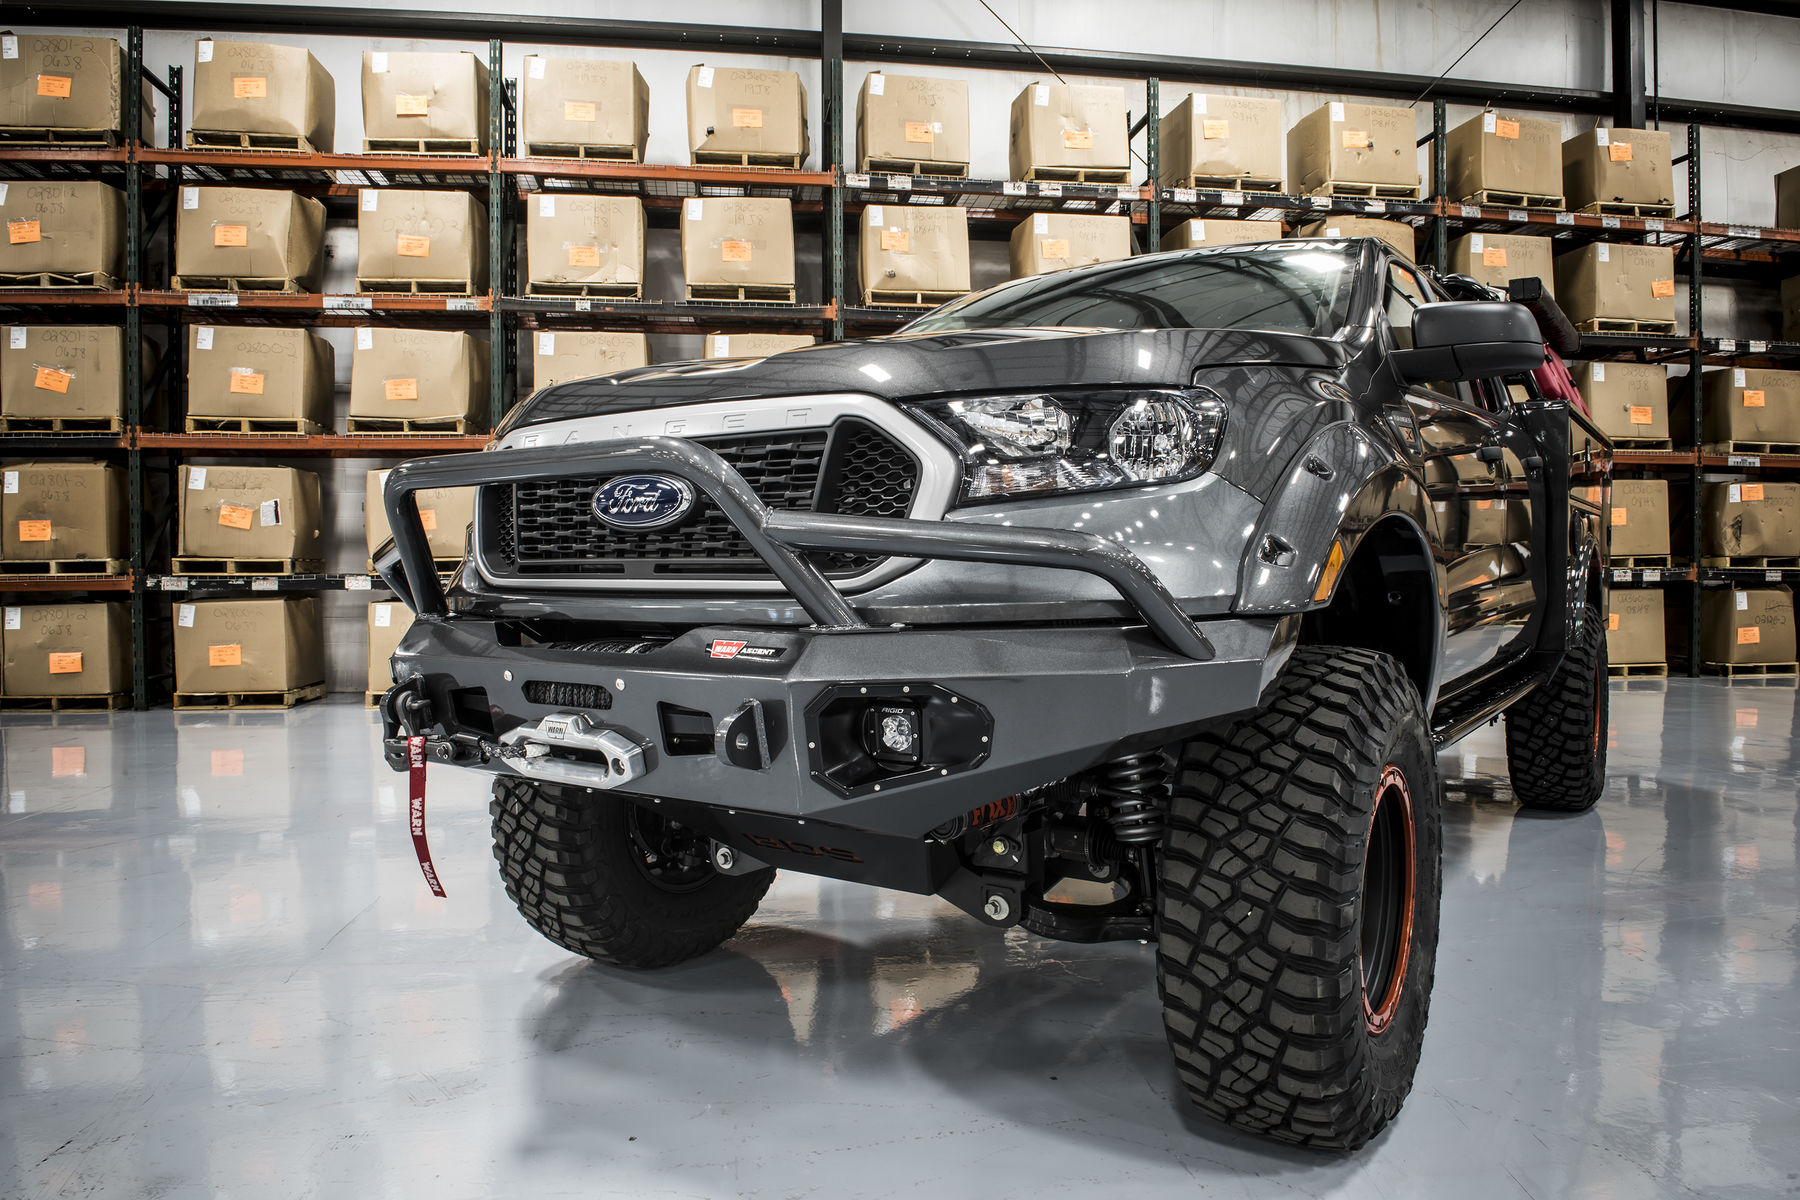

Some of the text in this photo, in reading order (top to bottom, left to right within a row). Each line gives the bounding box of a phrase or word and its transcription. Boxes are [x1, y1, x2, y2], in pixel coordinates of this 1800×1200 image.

[33, 39, 95, 54] 02801-2
[43, 55, 82, 70] 06J8
[608, 483, 663, 515] Ford
[41, 624, 73, 637] 06J8
[714, 645, 776, 656] WARN ASCENT
[410, 736, 424, 768] WARN
[411, 797, 423, 836] WARN
[421, 861, 442, 893] WARN
